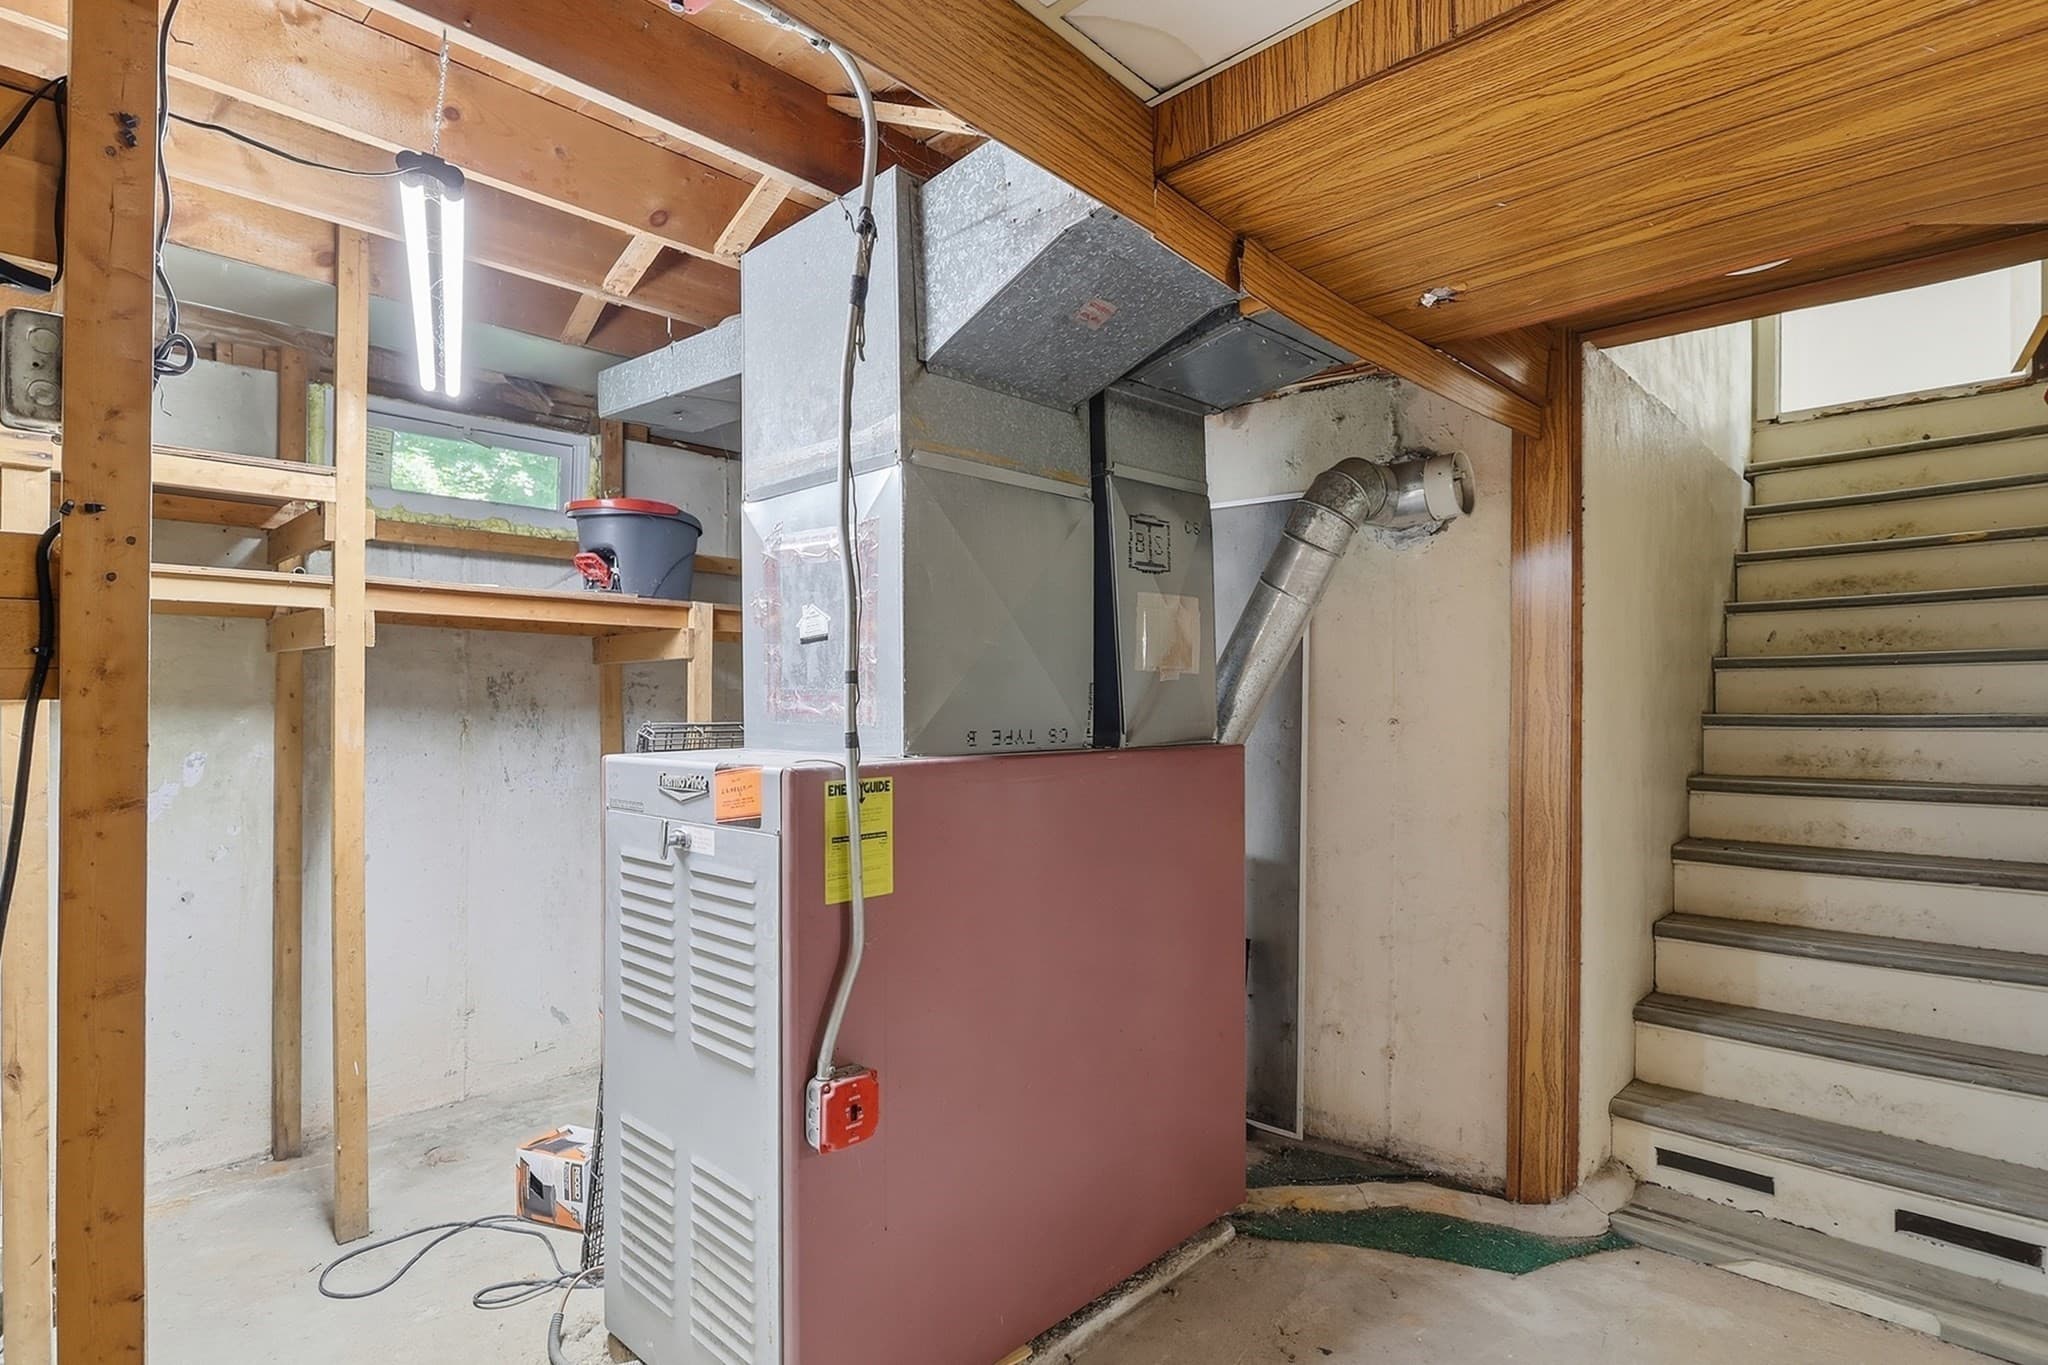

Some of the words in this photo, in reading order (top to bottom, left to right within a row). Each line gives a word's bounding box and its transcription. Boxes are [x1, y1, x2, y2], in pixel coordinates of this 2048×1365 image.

[1184, 520, 1201, 536] CS
[966, 729, 978, 747] B
[991, 728, 1036, 746] TYPE
[1047, 727, 1069, 744] CS
[828, 780, 891, 797] ENEYGUIDE
